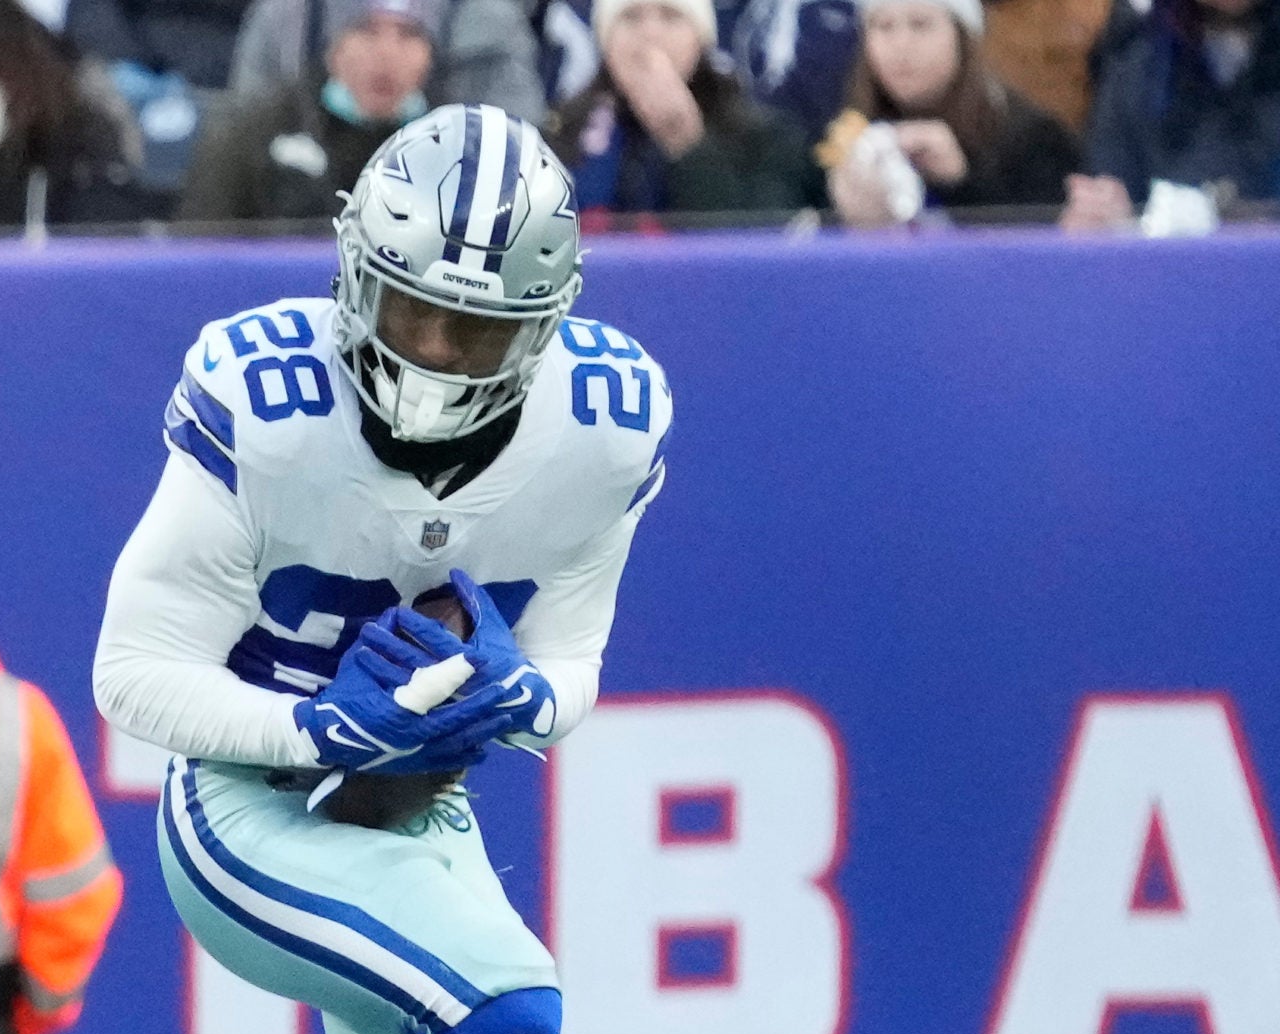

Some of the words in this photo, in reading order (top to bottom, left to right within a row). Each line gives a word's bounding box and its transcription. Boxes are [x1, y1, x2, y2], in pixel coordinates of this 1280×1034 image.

[442, 272, 489, 290] COWBOYS
[222, 308, 336, 423] 28
[559, 319, 651, 433] 28
[226, 562, 539, 698] 2
